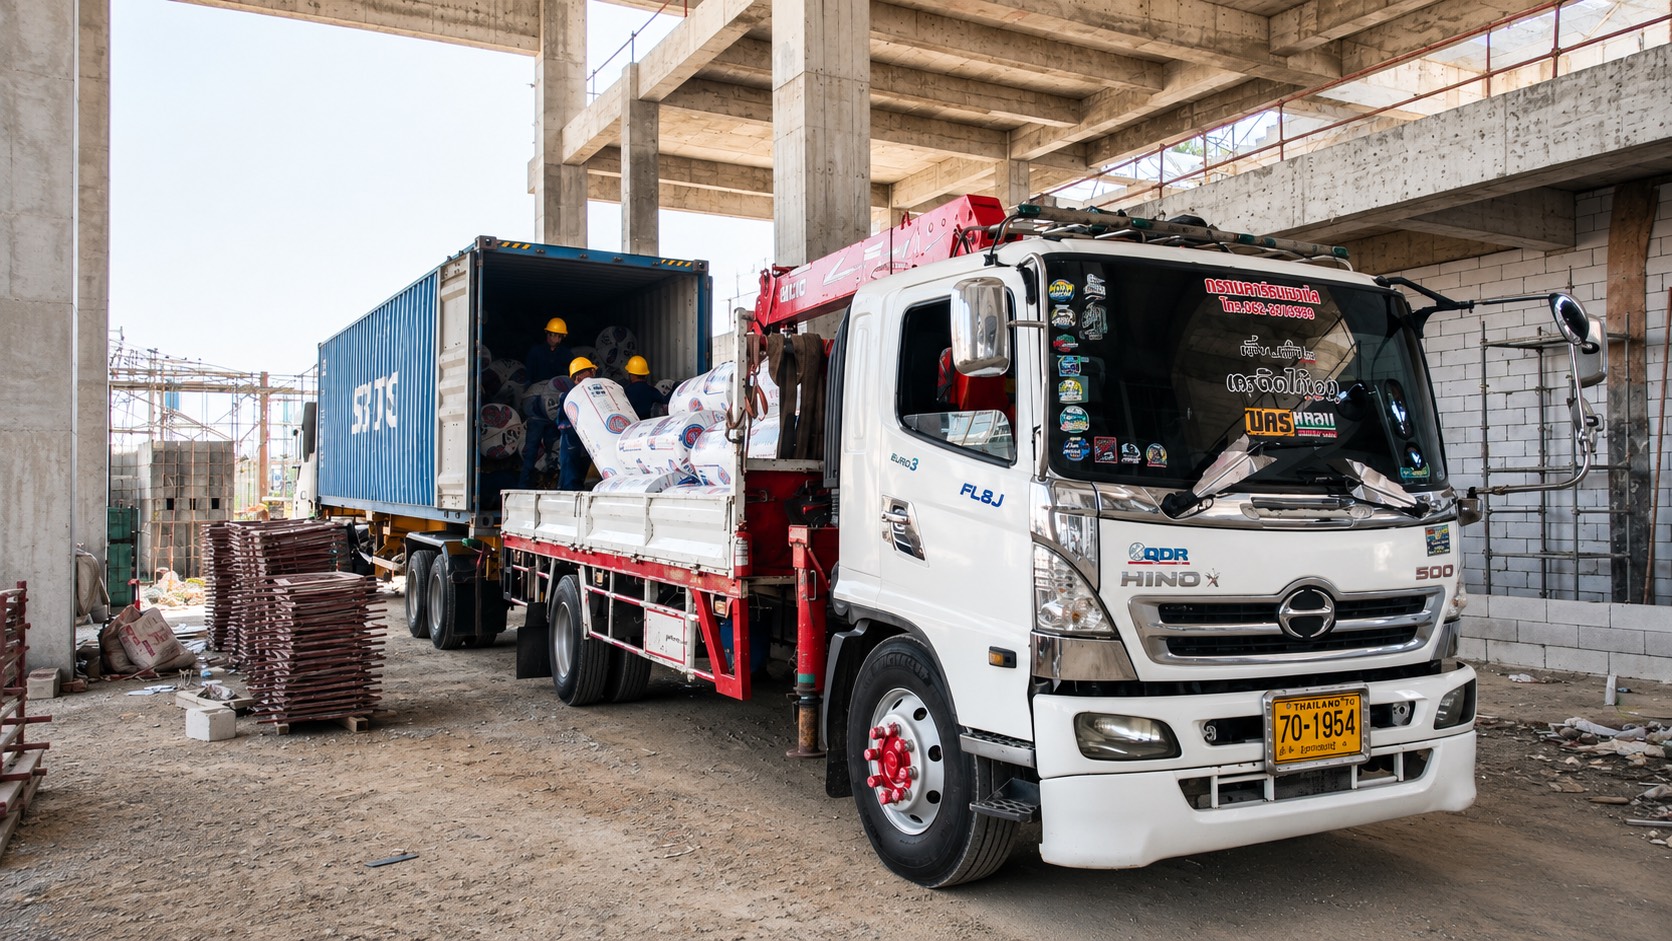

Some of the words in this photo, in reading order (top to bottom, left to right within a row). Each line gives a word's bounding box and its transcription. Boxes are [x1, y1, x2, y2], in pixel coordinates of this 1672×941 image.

[960, 483, 1004, 508] FL8J
[1144, 547, 1188, 562] QDR
[1120, 571, 1201, 587] HINO
[1415, 564, 1454, 580] 500
[1294, 700, 1340, 711] THAILAND
[1280, 709, 1355, 743] 70-1954
